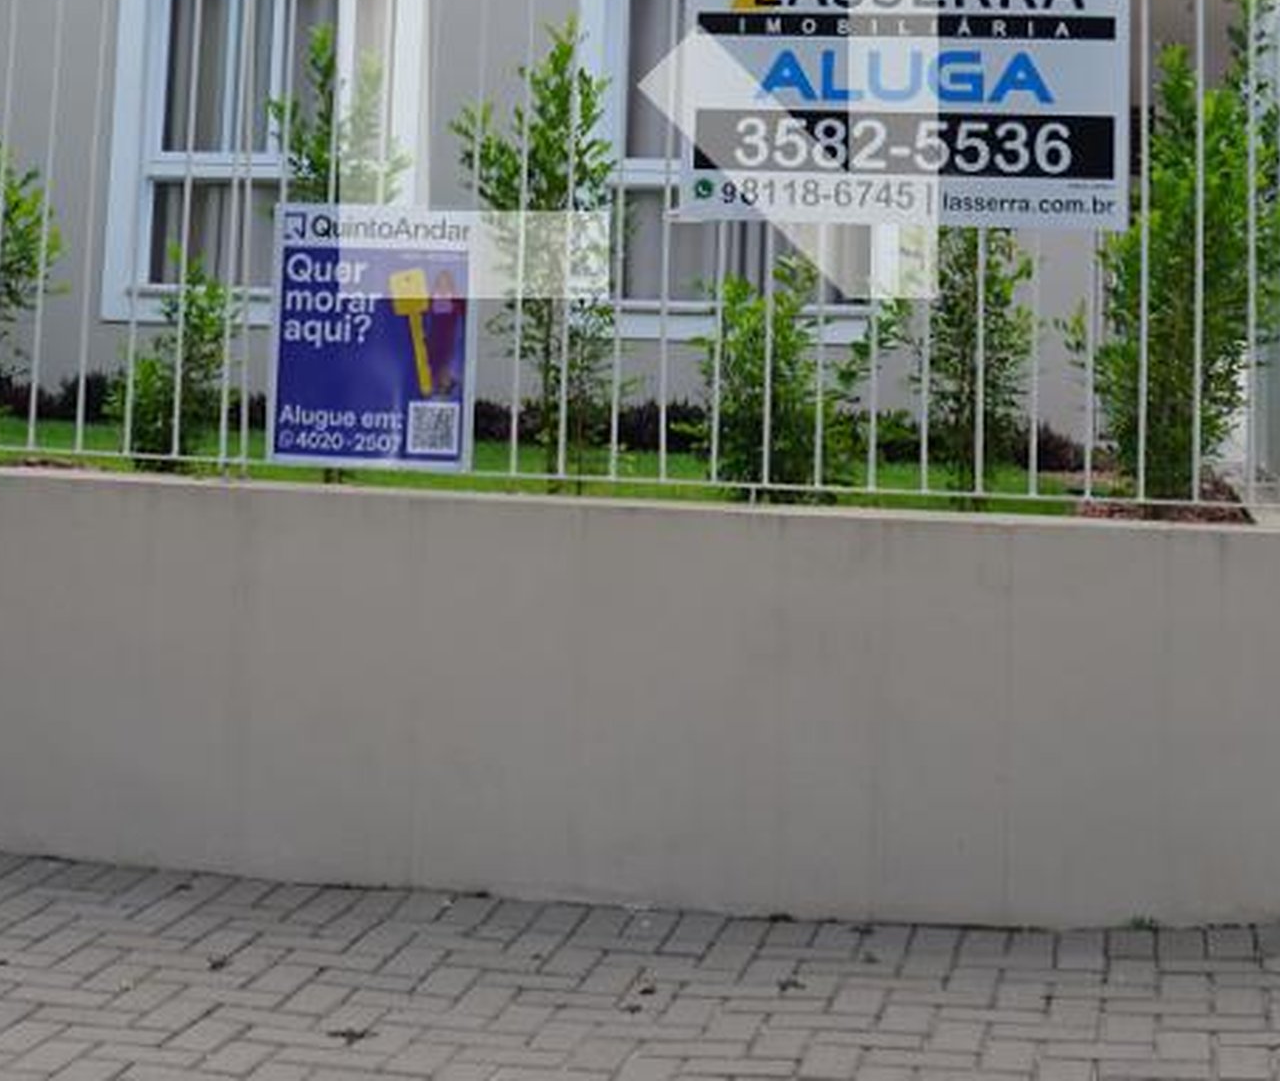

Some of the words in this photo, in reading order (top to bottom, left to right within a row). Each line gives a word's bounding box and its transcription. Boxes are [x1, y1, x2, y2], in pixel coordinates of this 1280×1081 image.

[759, 49, 1054, 104] ALUGA
[733, 117, 1073, 174] 3582-5536
[722, 178, 915, 211] 98118-6745
[943, 192, 1116, 215] lasserra.com.br
[311, 215, 470, 242] QuintoAndar
[286, 253, 367, 284] Quer
[285, 288, 382, 314] morar
[283, 314, 372, 349] aqui?
[280, 405, 357, 431] Alugue
